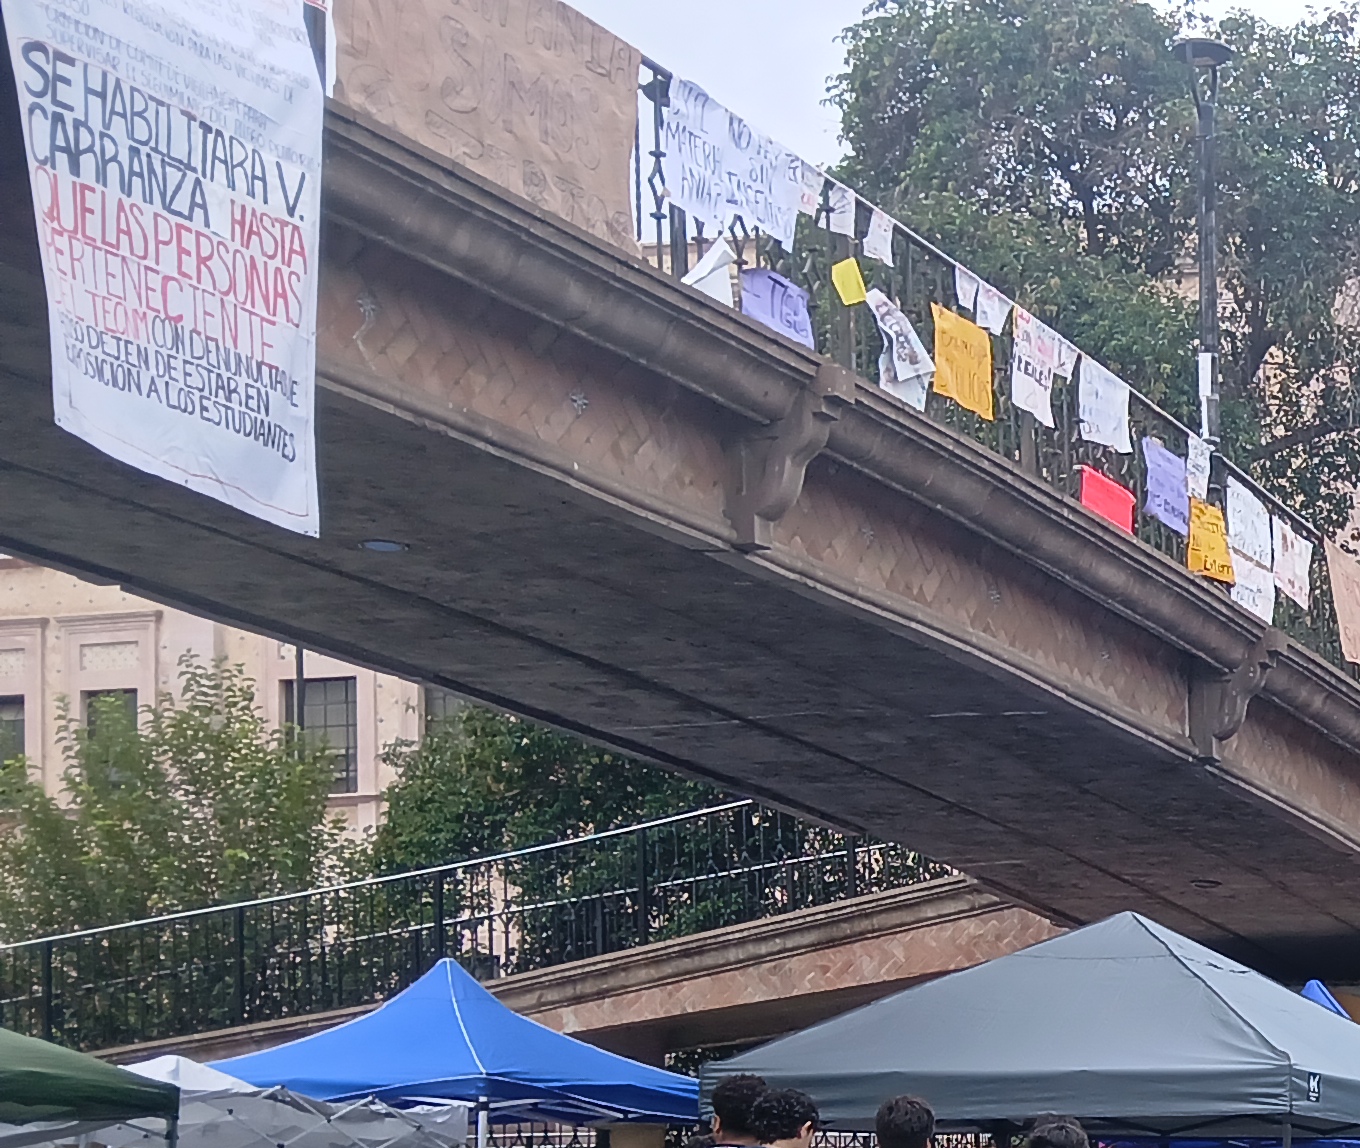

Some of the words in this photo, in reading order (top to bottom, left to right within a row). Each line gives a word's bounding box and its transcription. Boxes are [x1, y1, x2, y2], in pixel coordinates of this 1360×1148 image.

[21, 41, 76, 112] SE
[84, 62, 267, 205] HABILITARA
[276, 160, 305, 222] V.
[28, 101, 210, 230] CARRANZA
[230, 198, 308, 275] HASTA
[154, 212, 302, 328] PERSONAS
[86, 324, 149, 372] DEJEN
[154, 349, 178, 383] DE
[183, 358, 242, 408] ESTAR
[244, 382, 270, 418] EN
[151, 314, 184, 355] CON
[147, 375, 162, 404] A
[165, 380, 195, 416] LOS
[199, 394, 296, 463] ESTUDIANTES
